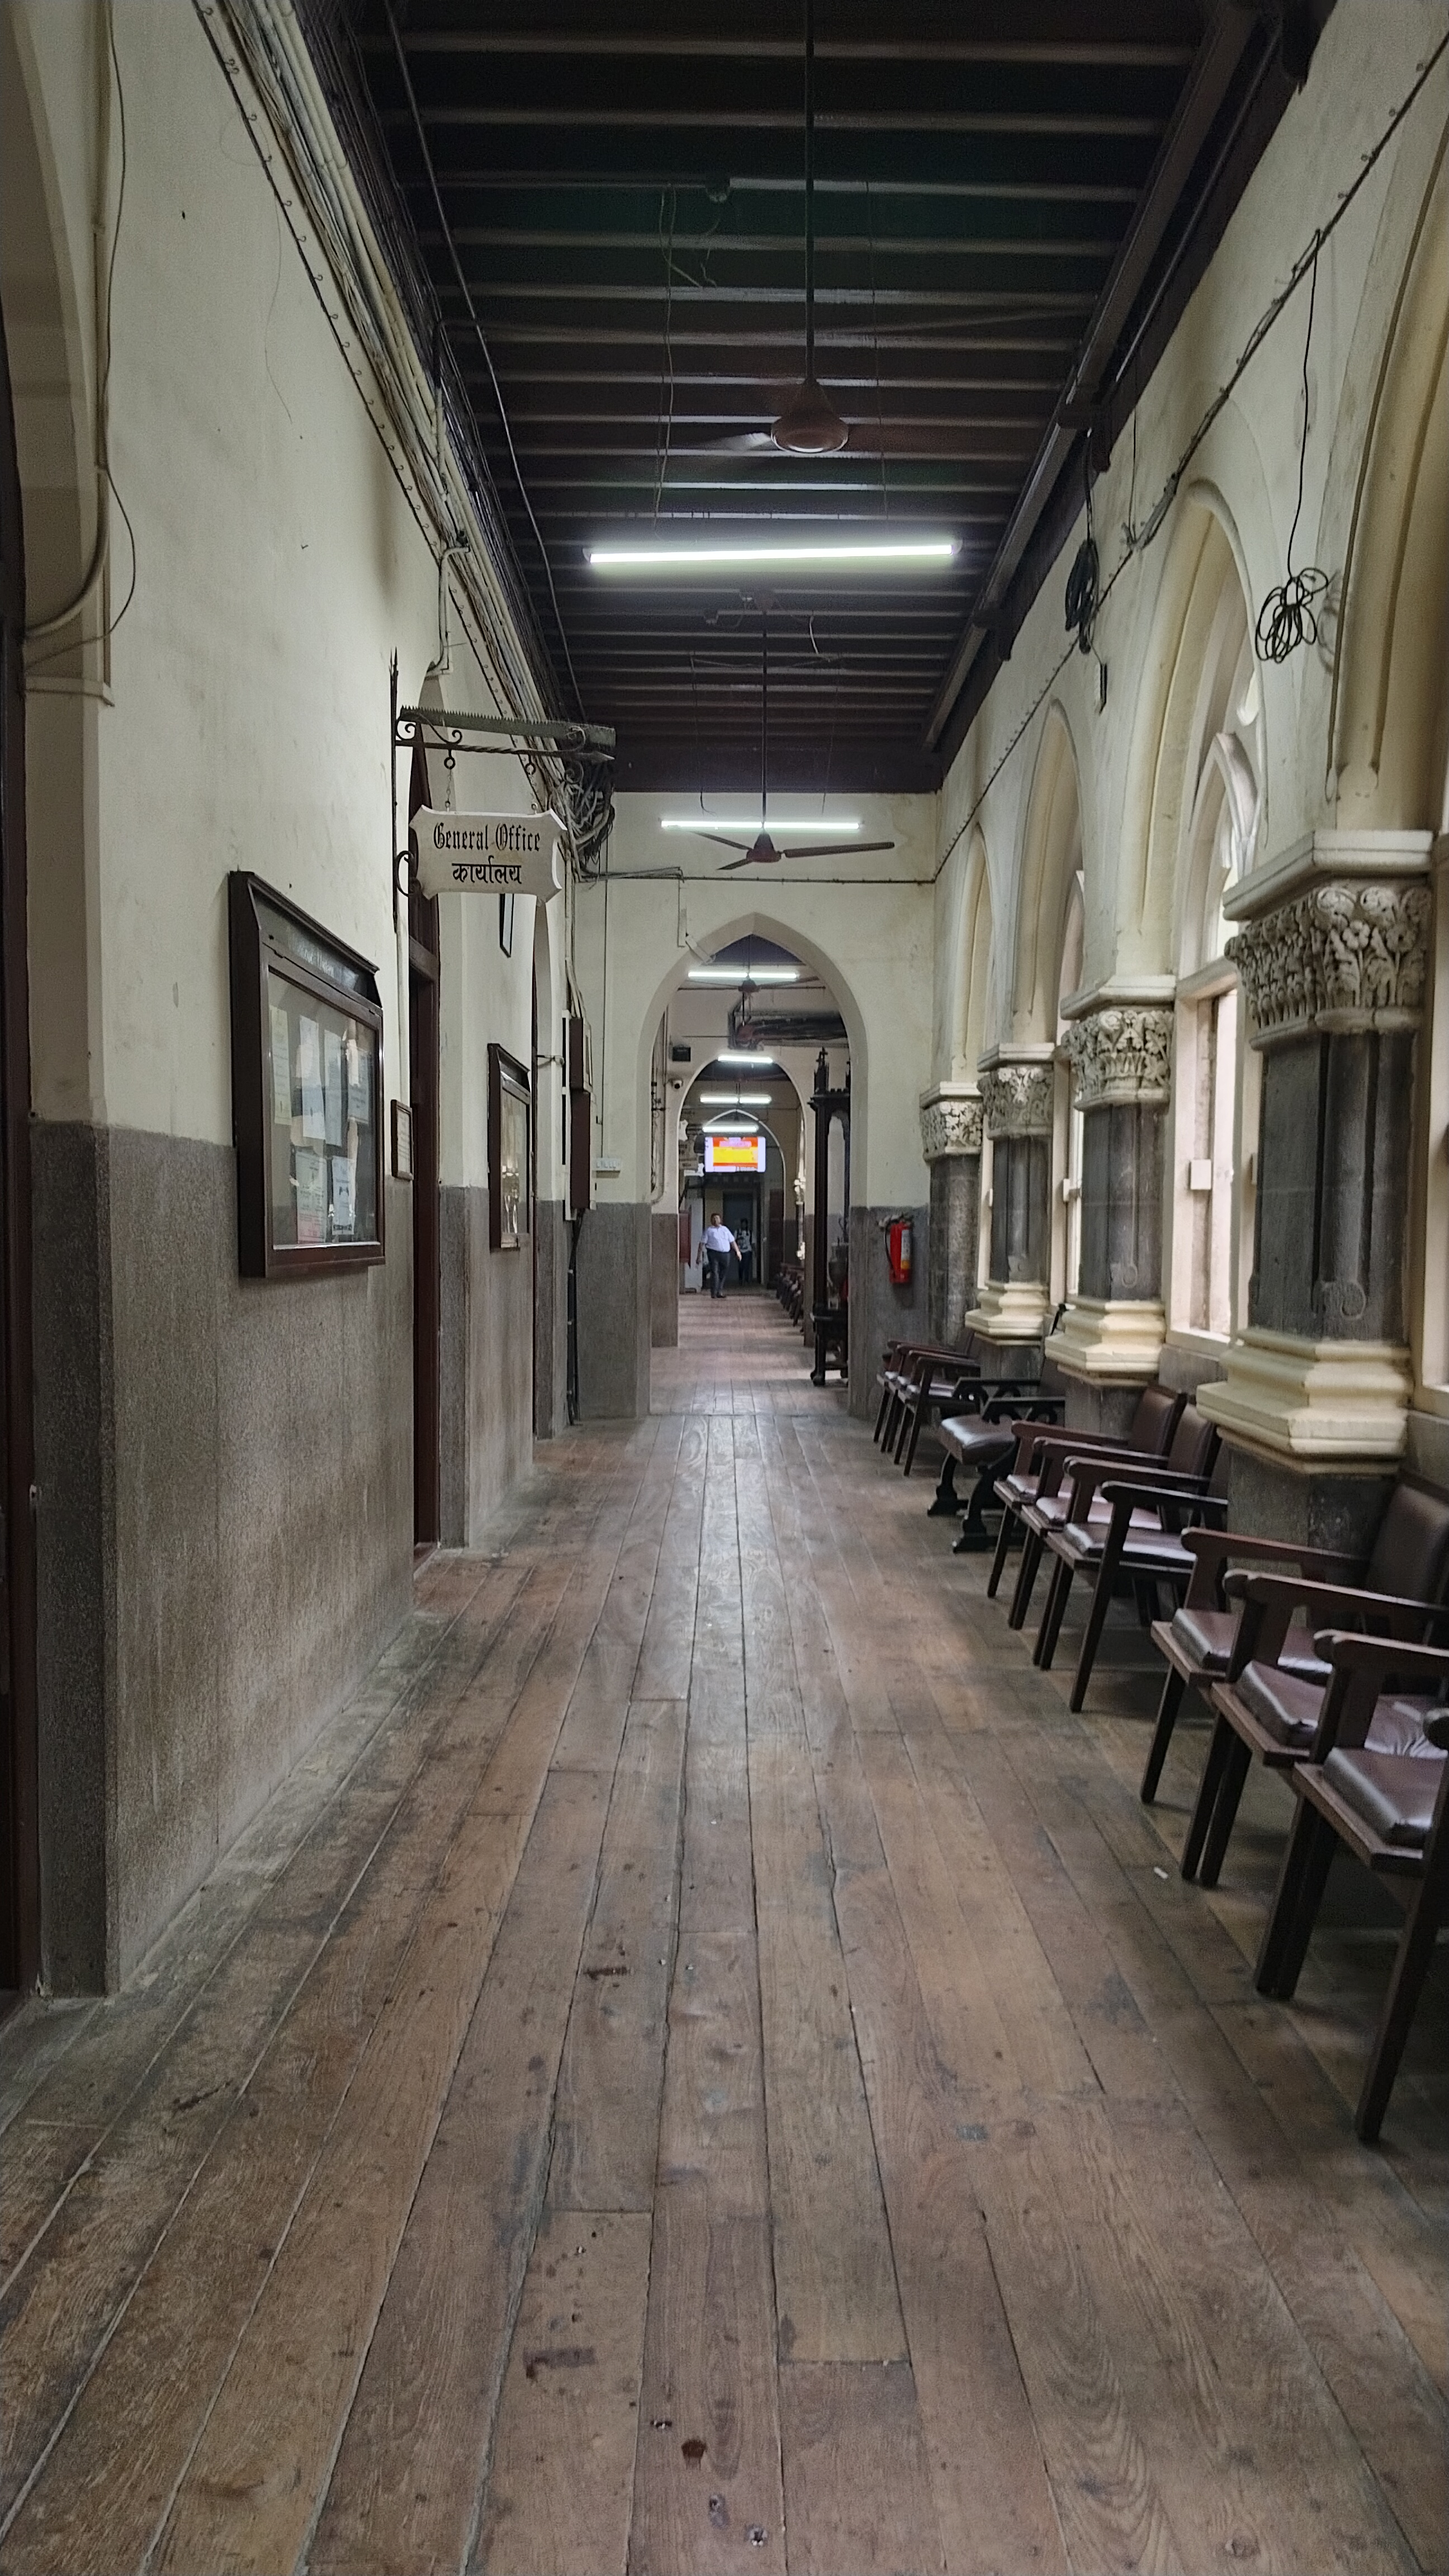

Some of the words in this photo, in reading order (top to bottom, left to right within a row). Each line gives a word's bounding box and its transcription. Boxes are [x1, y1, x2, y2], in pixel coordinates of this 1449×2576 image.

[433, 822, 489, 850] General
[495, 822, 541, 851] Office
[452, 855, 522, 884] कार्यालय
